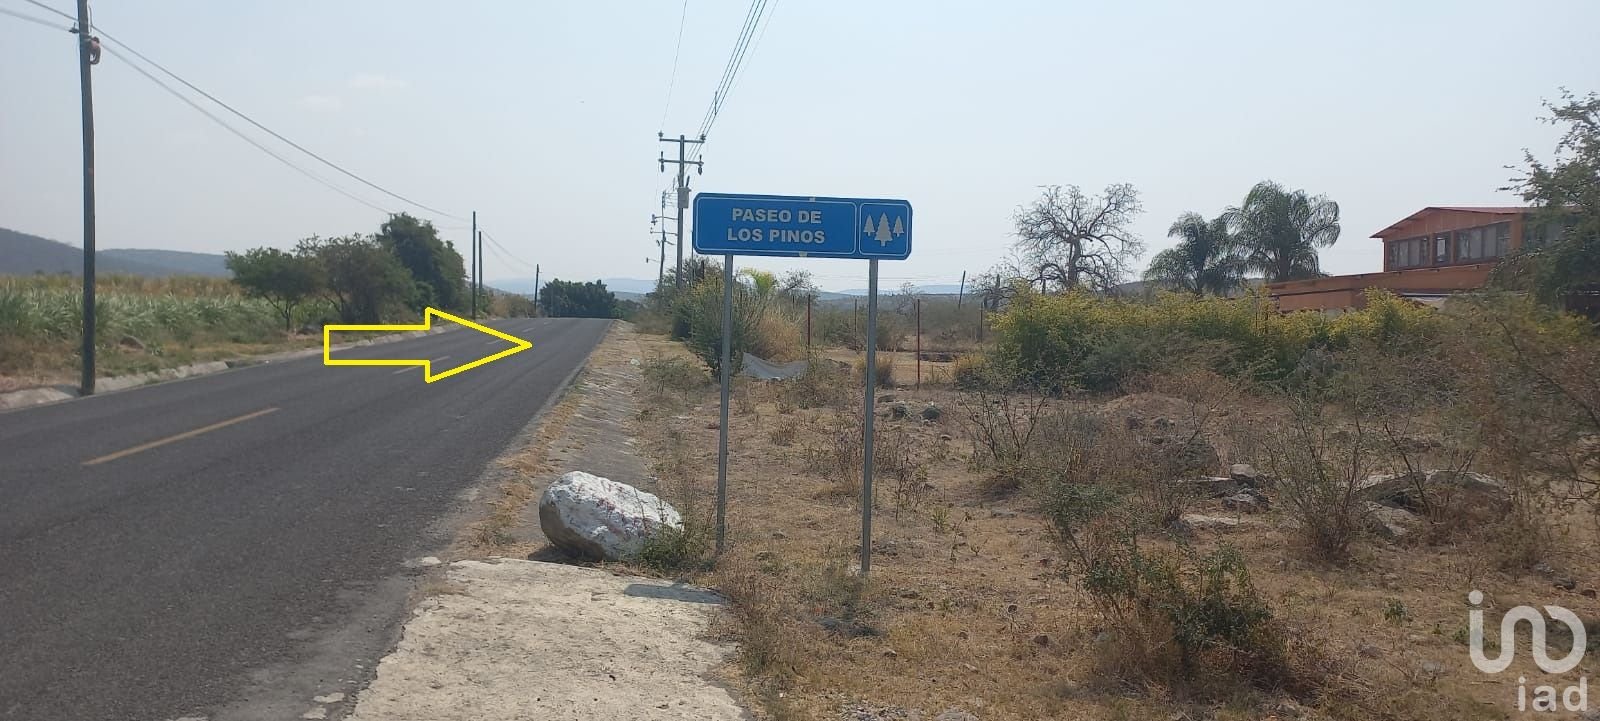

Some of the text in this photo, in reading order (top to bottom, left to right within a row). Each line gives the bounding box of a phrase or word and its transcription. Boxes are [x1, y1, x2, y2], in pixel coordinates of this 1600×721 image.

[732, 208, 822, 224] PASEO DE
[727, 228, 825, 244] LOS PINOS
